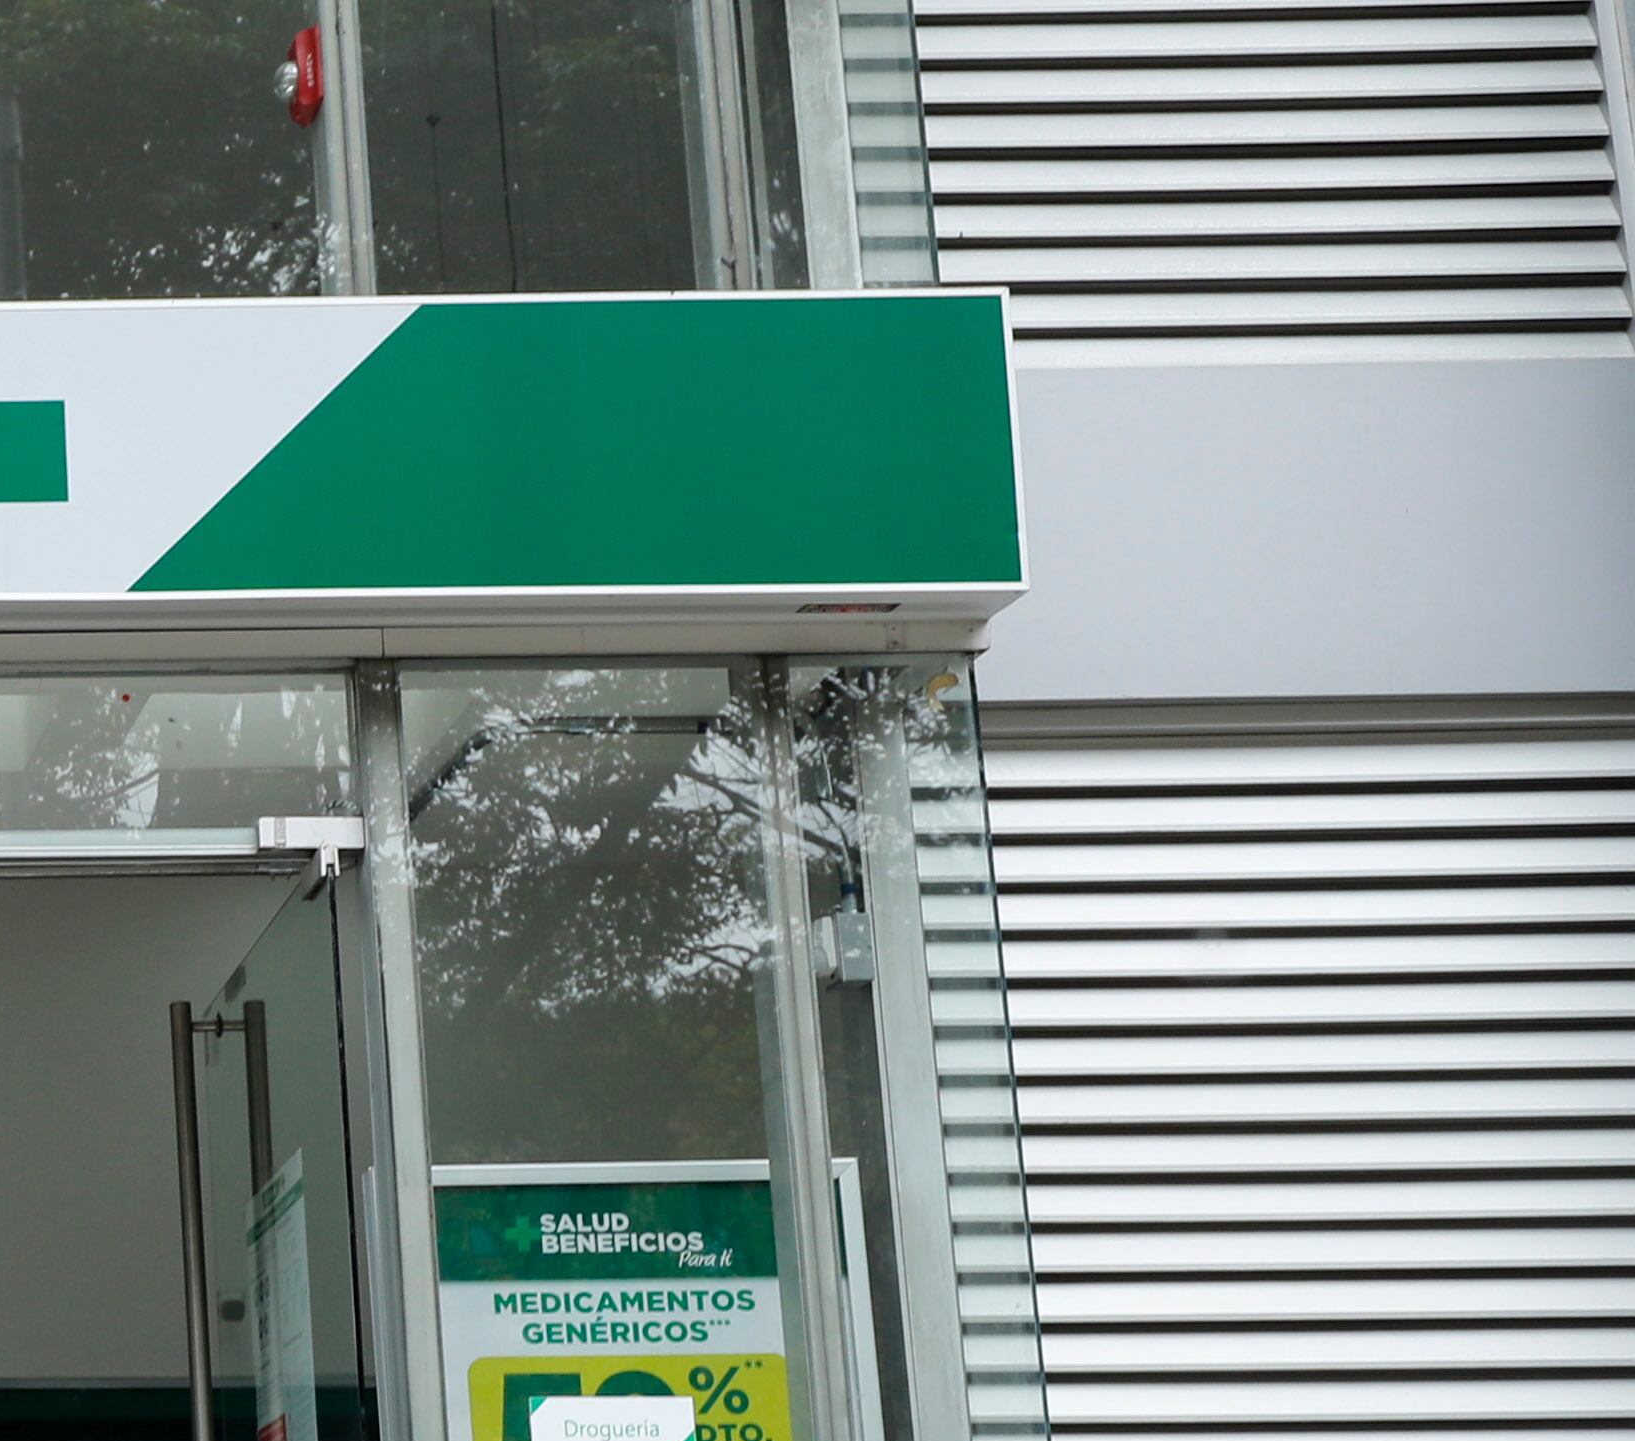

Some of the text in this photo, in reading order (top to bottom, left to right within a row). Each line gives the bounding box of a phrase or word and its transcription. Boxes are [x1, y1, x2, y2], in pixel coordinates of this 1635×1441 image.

[539, 1212, 630, 1233] SALUD
[541, 1231, 705, 1255] BENEFICIOS
[677, 1249, 718, 1268] Para
[493, 1289, 756, 1315] MEDICAMENTOS
